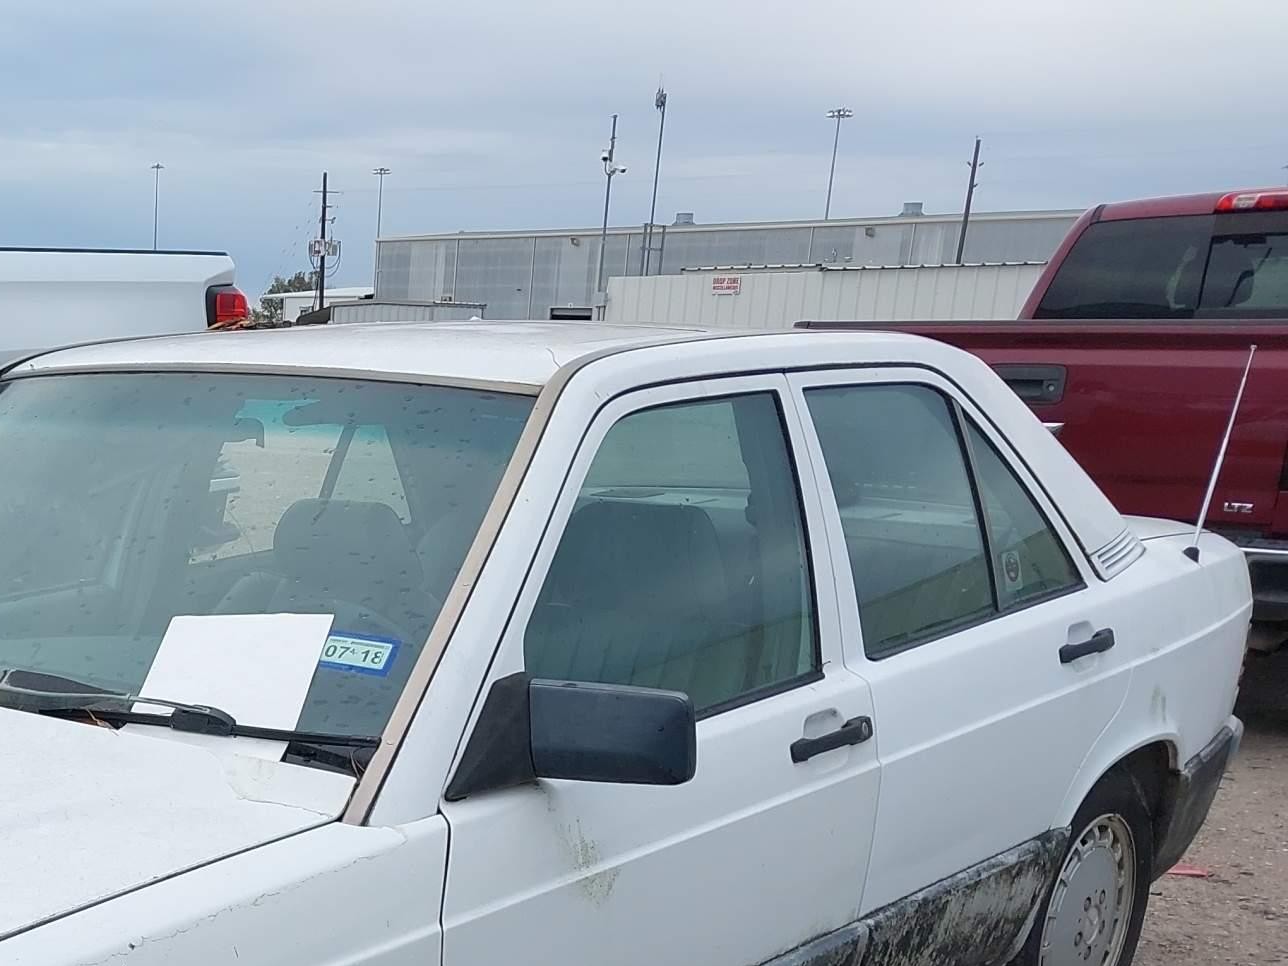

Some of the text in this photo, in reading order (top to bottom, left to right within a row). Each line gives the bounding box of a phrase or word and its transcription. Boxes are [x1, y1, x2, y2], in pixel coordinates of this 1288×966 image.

[1223, 502, 1254, 513] LTZ
[324, 644, 385, 665] 07 18
